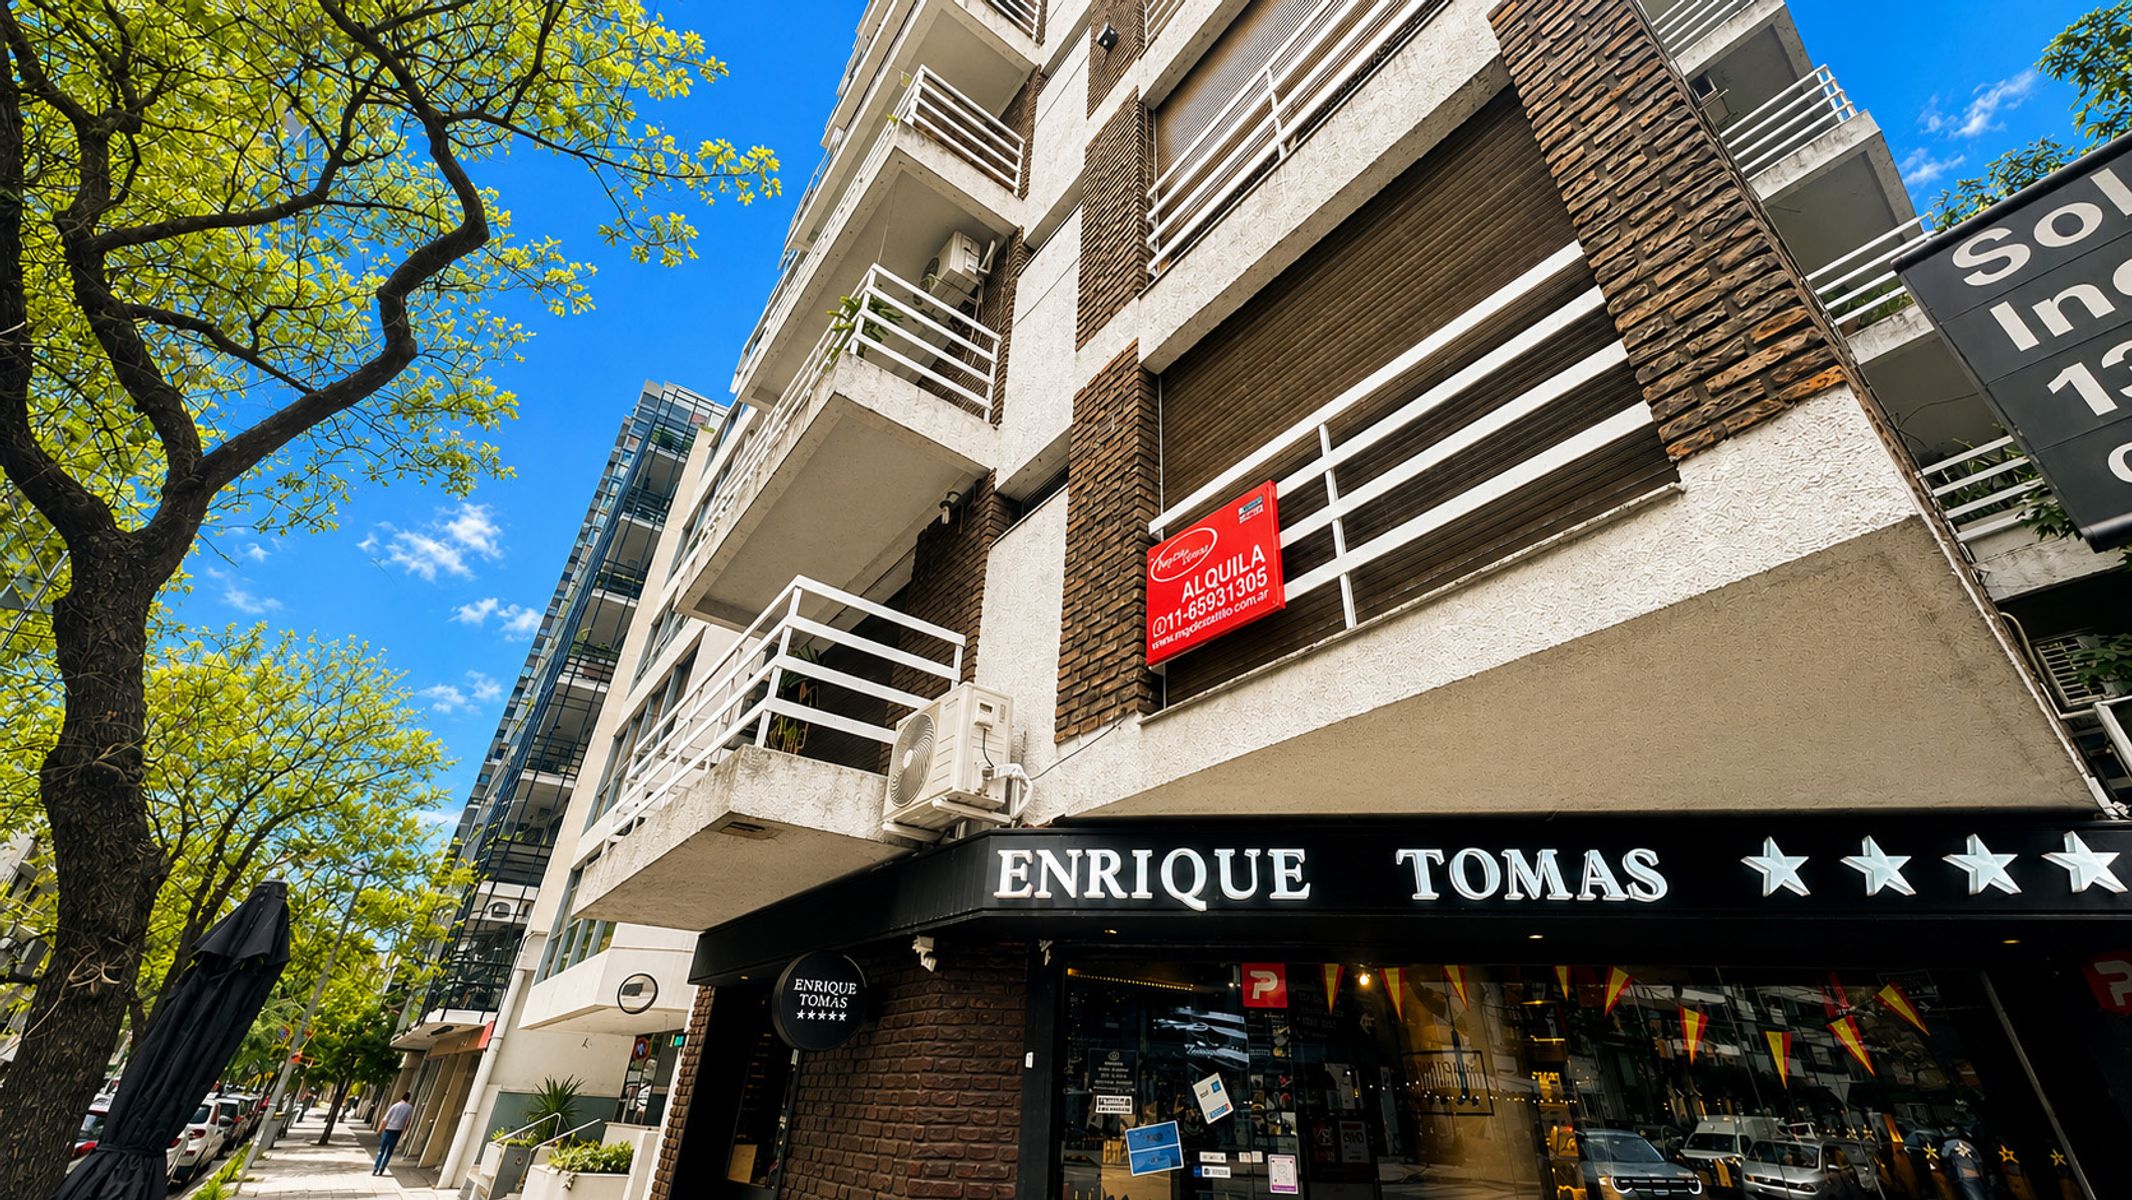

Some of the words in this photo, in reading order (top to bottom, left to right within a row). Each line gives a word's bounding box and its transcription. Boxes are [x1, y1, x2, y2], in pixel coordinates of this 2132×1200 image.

[1166, 566, 1268, 631] 11-65931305
[1181, 544, 1266, 603] ALQUILA
[993, 848, 1310, 911] ENRIQUE
[1396, 848, 1668, 902] TOMAS
[793, 978, 857, 996] ENRIQUE
